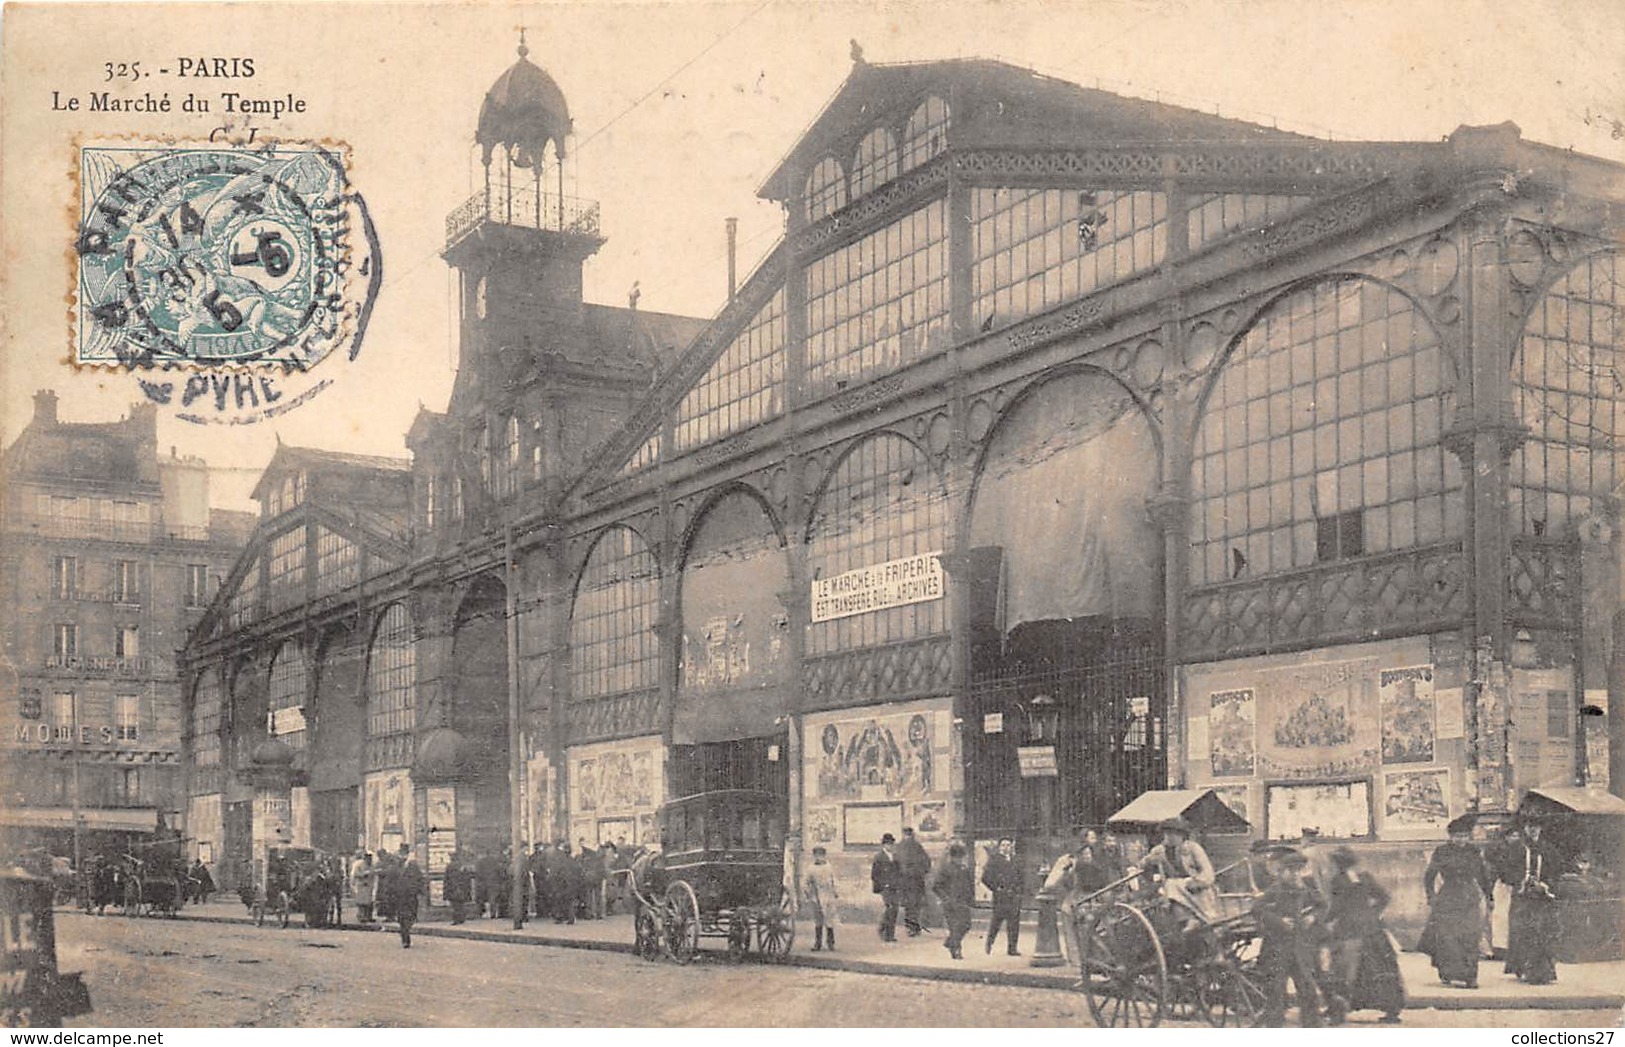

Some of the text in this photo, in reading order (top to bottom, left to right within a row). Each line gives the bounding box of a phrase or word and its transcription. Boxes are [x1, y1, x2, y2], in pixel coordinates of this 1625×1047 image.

[818, 580, 828, 597] LE
[885, 555, 936, 583] FRIPERIE
[897, 575, 938, 601] ARCHIVES
[14, 723, 112, 745] MODES
